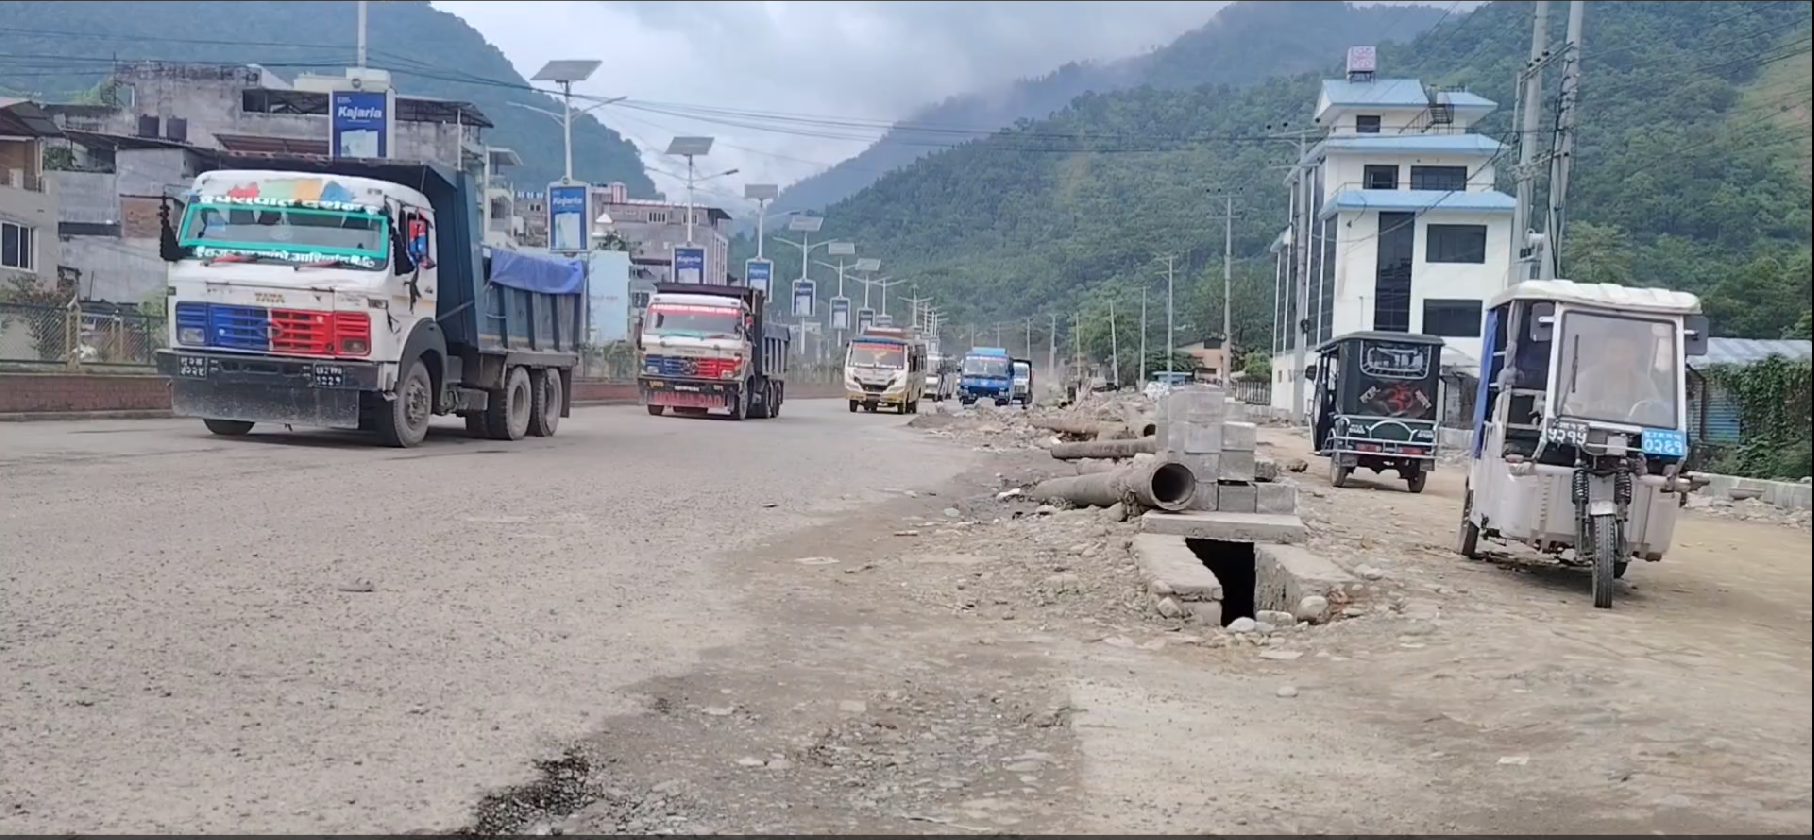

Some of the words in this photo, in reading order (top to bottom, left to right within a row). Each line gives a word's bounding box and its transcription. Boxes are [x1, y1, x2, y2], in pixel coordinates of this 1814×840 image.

[337, 106, 383, 120] Kajaria
[254, 292, 285, 303] TATA
[1547, 428, 1588, 446] ५२१५
